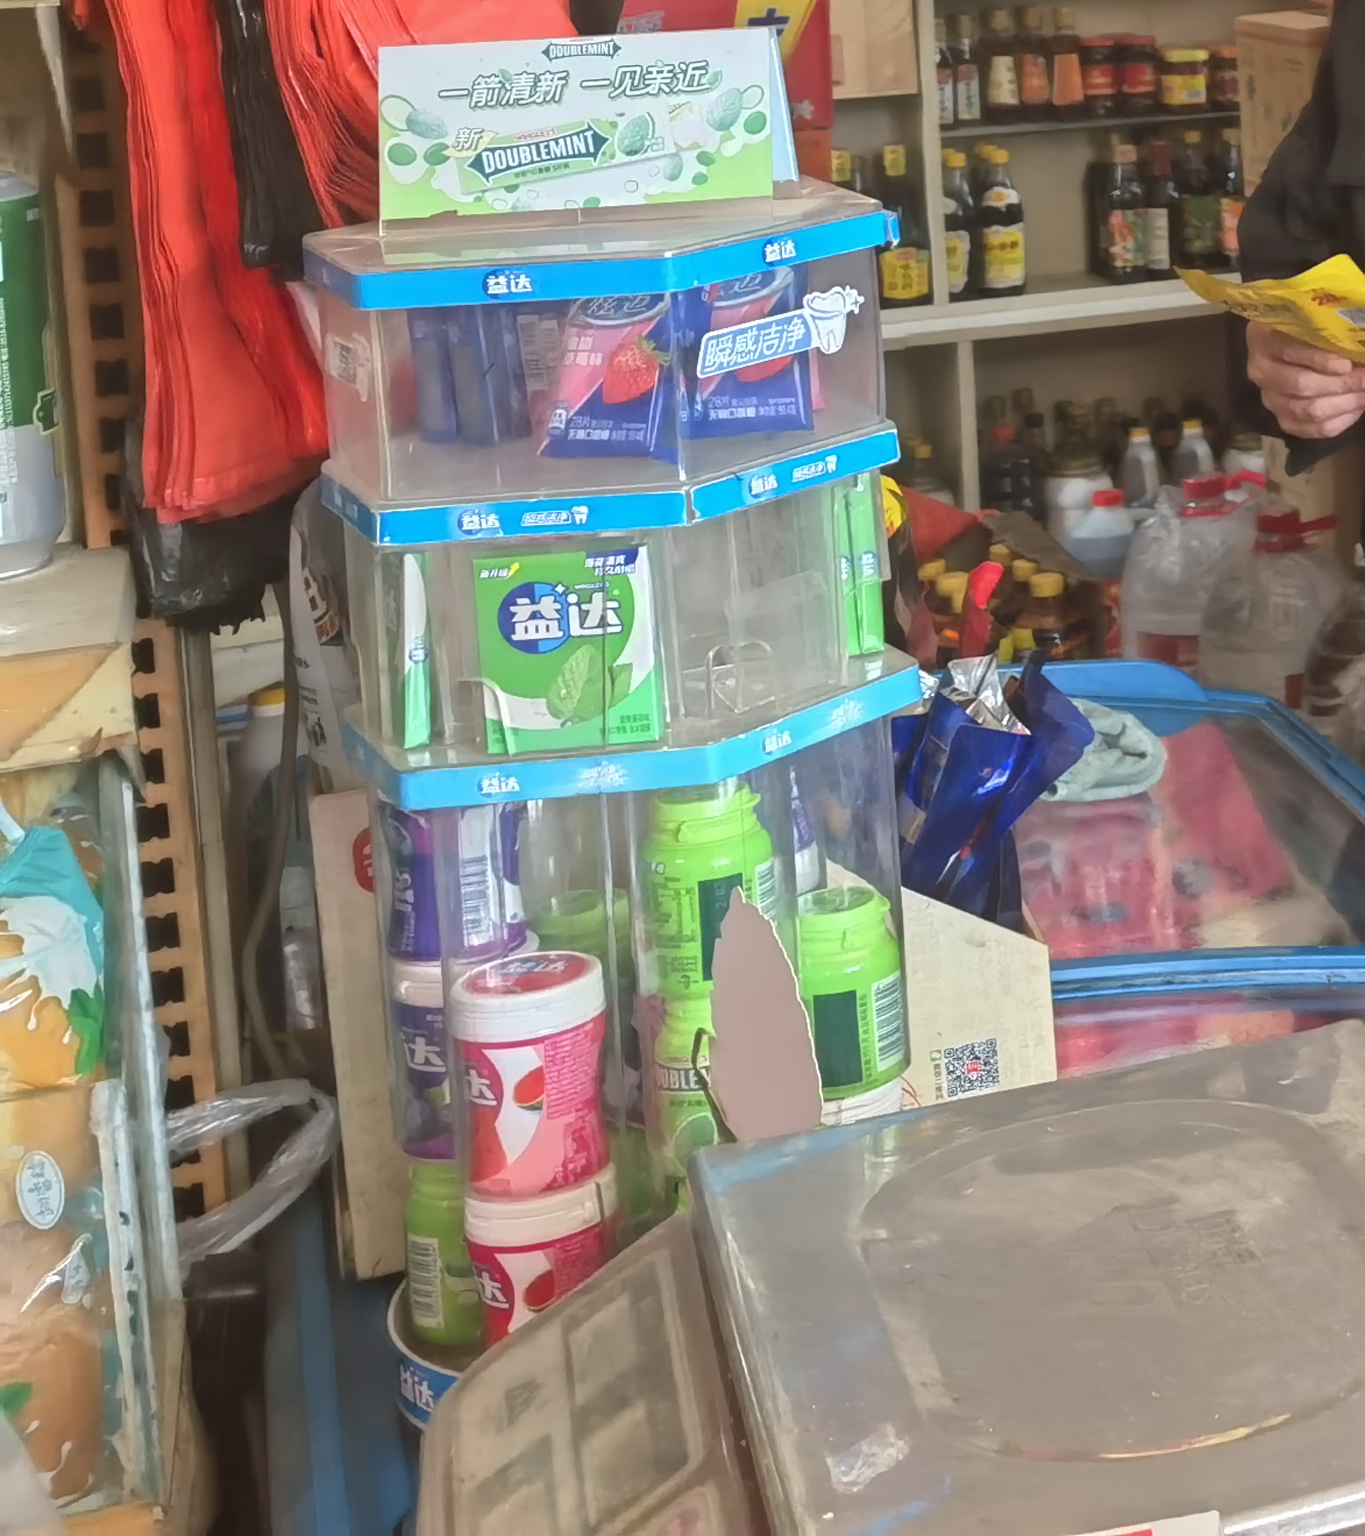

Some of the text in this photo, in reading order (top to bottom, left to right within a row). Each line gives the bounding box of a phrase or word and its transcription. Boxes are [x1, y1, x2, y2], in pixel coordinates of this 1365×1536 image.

[549, 40, 616, 58] DOUBLEMINT
[438, 58, 712, 109] 一箭清新 一见亲近
[455, 126, 484, 152] 新
[481, 129, 598, 175] DOUBLEMINT
[764, 239, 797, 263] 益达
[486, 273, 534, 295] 益达
[704, 318, 807, 370] 瞬感洁净
[509, 589, 624, 642] 益达
[400, 1031, 447, 1073] 达
